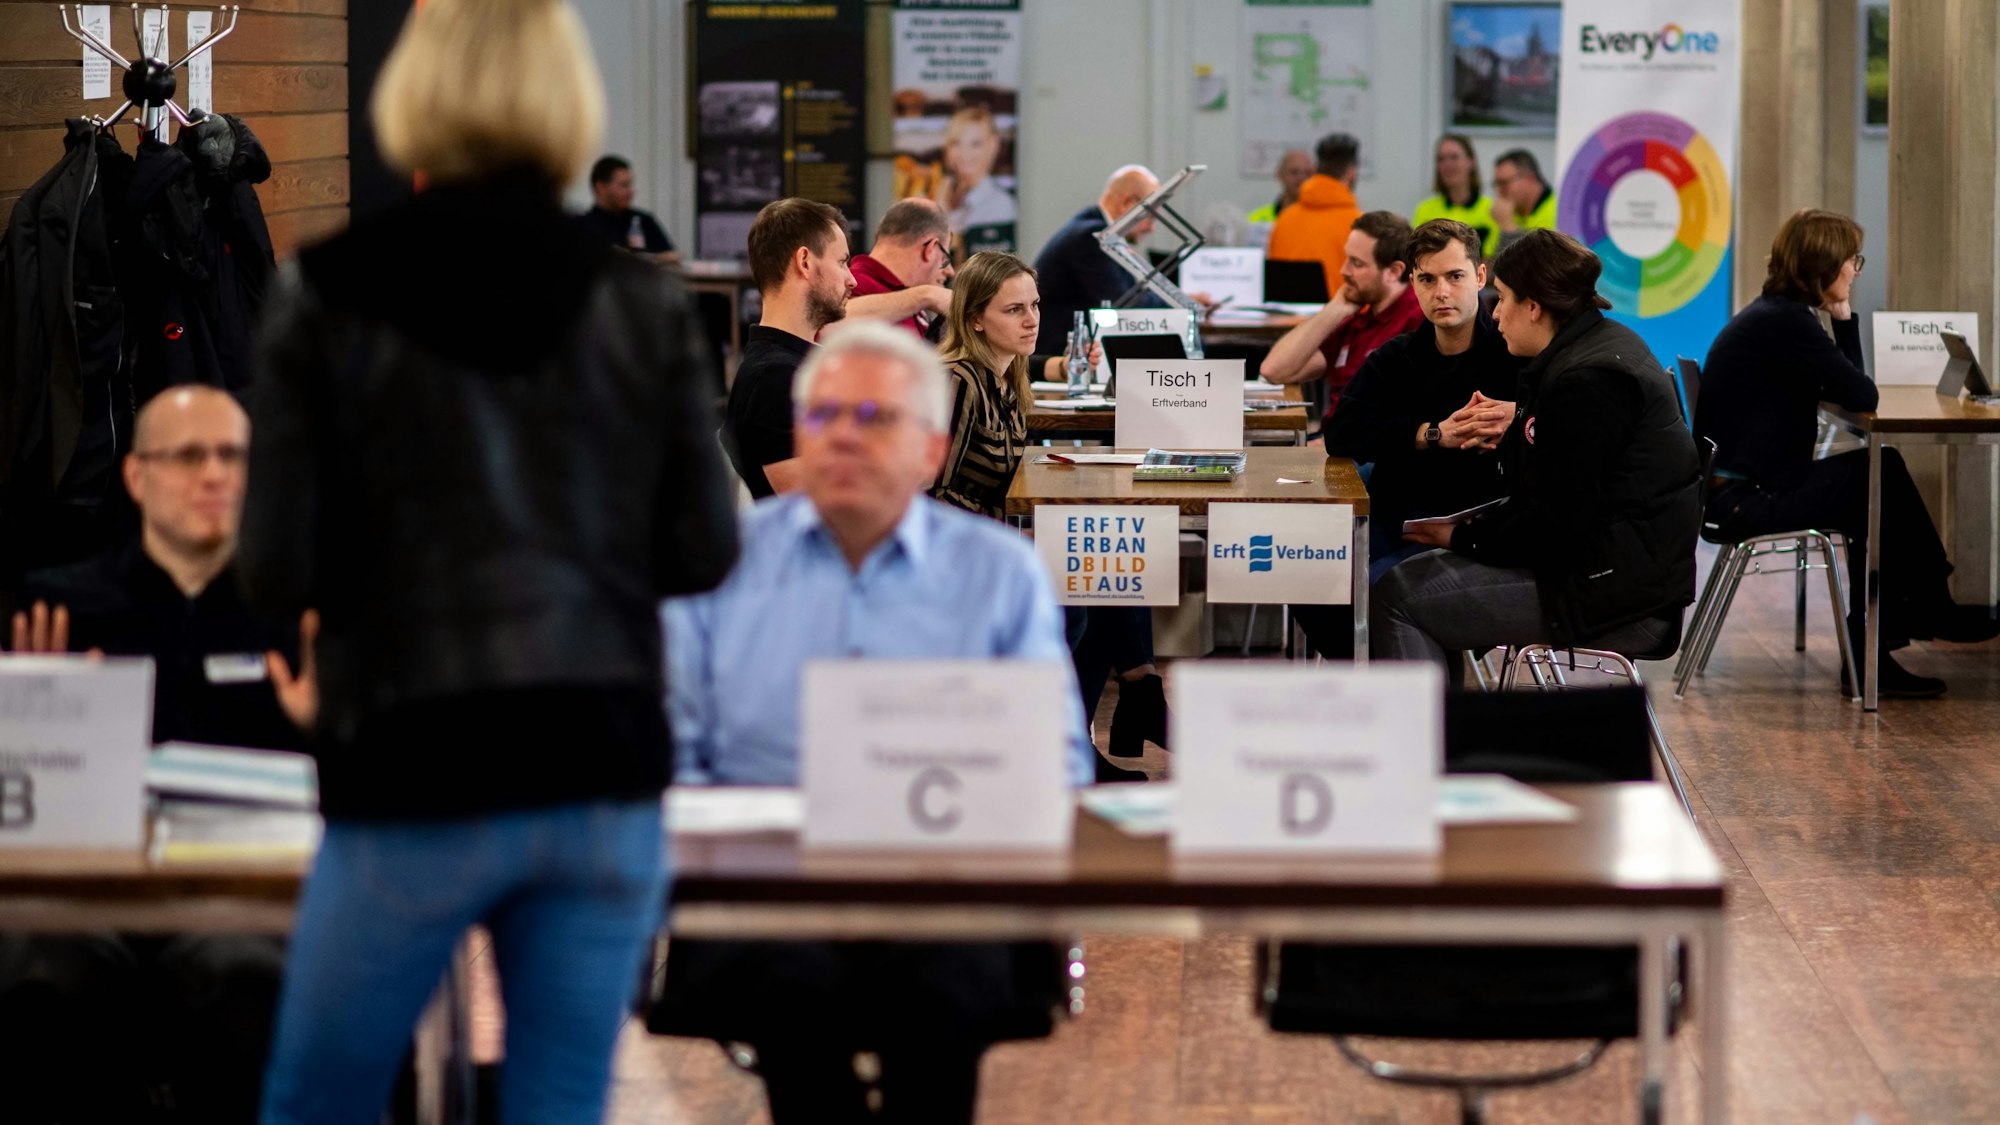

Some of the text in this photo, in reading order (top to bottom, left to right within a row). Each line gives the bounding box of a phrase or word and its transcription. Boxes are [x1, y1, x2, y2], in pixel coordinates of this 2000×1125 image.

[1580, 22, 1719, 61] EveryOne
[1118, 318, 1168, 331] Tisch 4
[1898, 320, 1940, 335] Tisch
[1907, 344, 1935, 352] service
[1146, 370, 1211, 387] Tisch 1
[1152, 398, 1208, 408] Erftverband
[1067, 516, 1145, 533] ERFTV
[1067, 536, 1145, 553] ERBAN
[1213, 543, 1347, 560] Erft Verband
[0, 768, 36, 830] B
[906, 766, 964, 834] C
[1279, 771, 1335, 837] D
